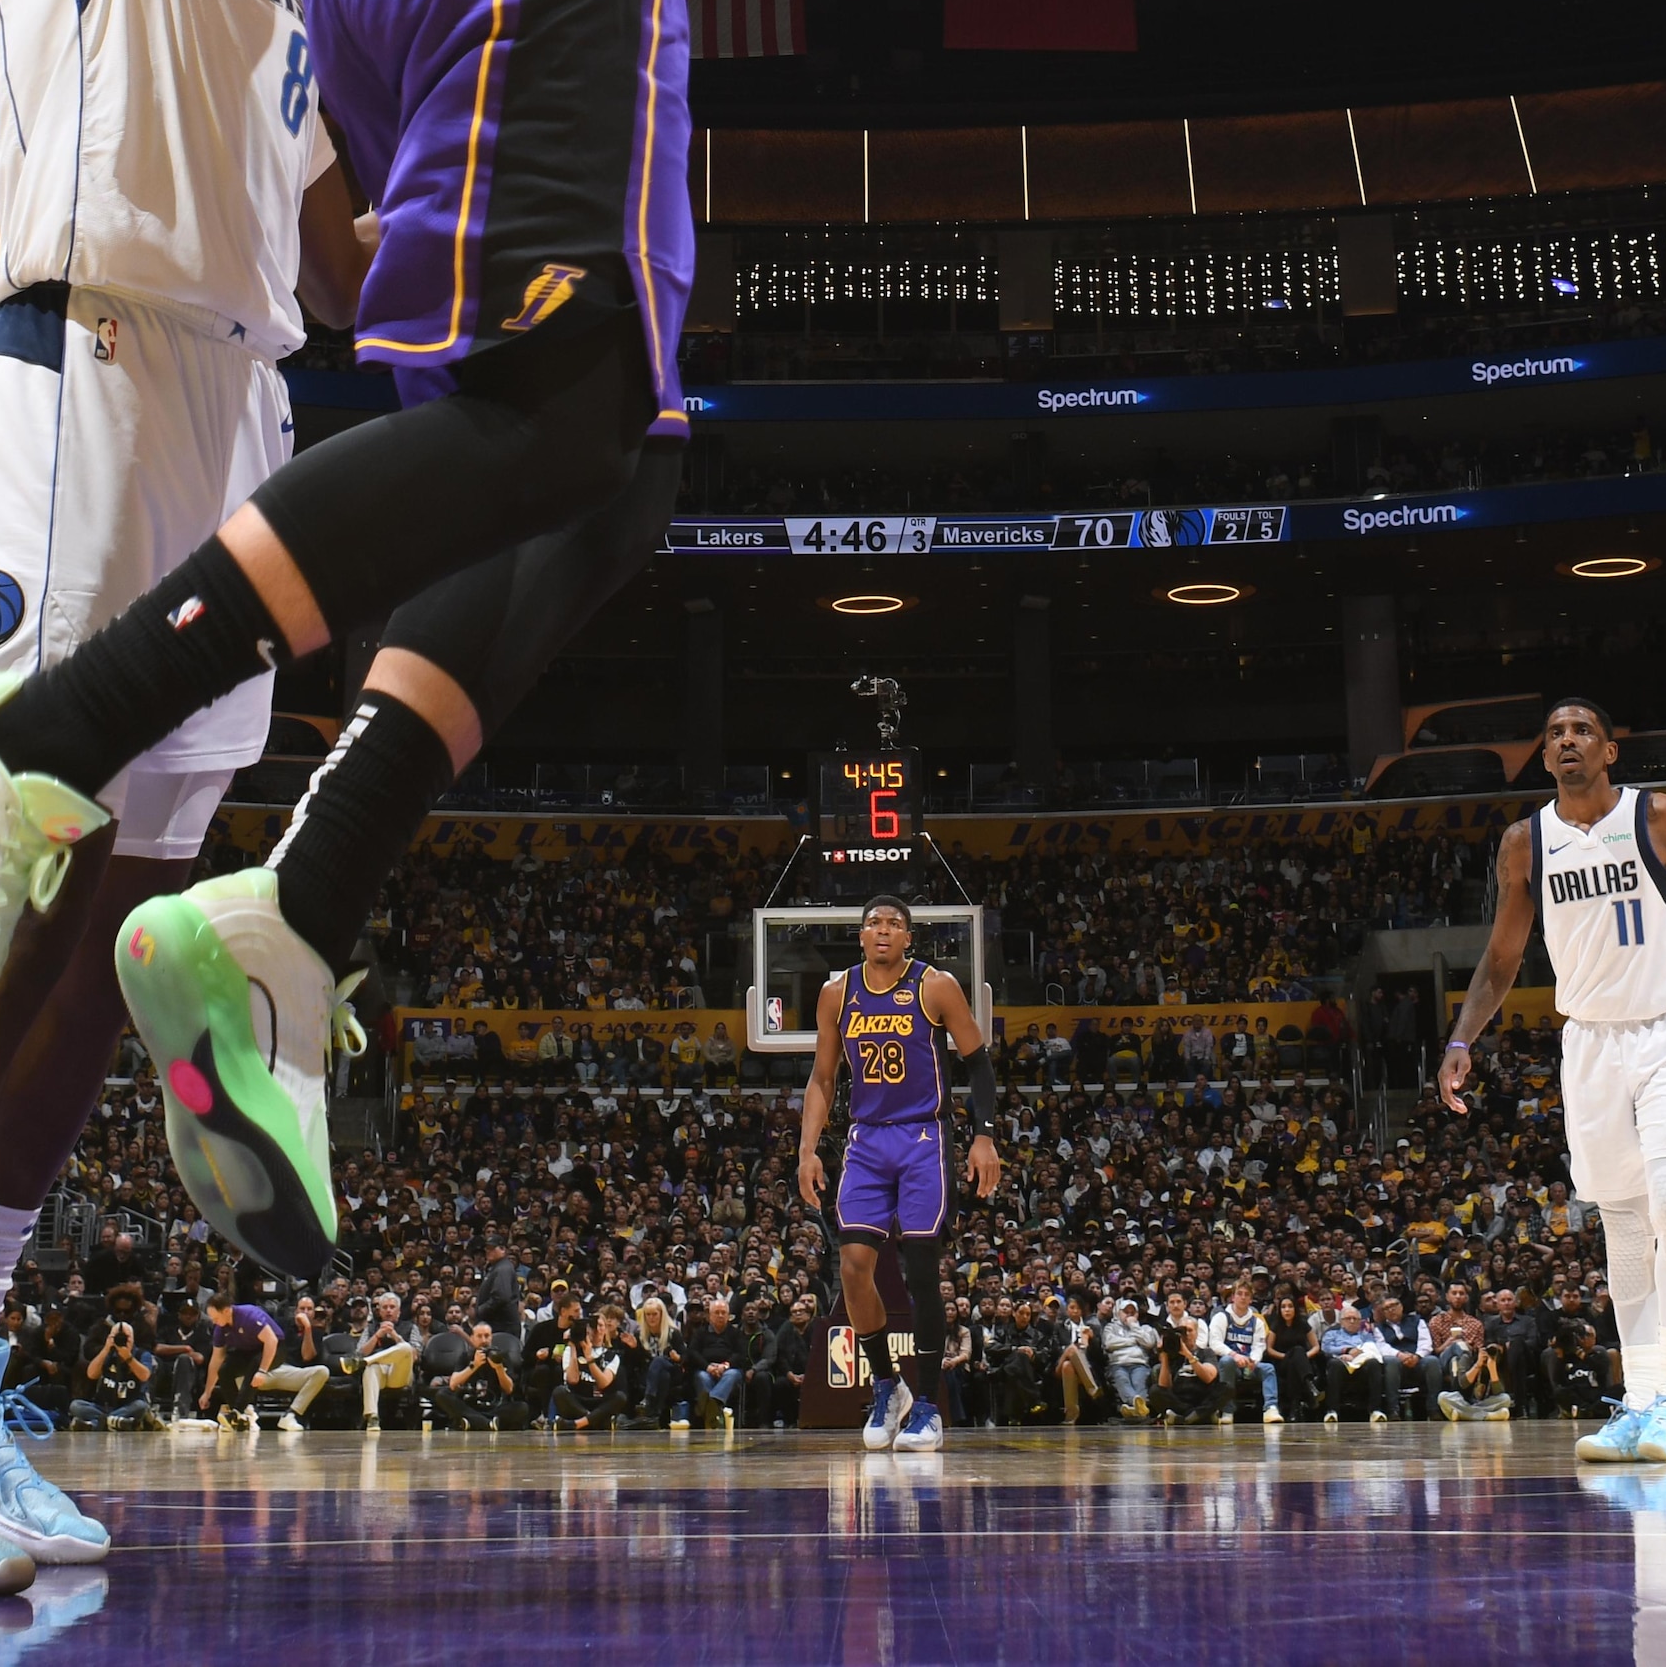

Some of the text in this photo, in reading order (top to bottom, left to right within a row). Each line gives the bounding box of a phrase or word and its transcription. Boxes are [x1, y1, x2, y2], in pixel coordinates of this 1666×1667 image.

[281, 29, 314, 139] 8
[1471, 357, 1575, 385] Spectrum
[1036, 389, 1138, 412] Spectrum
[910, 518, 927, 527] QTR
[1217, 511, 1247, 522] FOULS
[1256, 510, 1275, 520] TOL
[1342, 503, 1457, 534] Spectrum
[696, 527, 764, 546] Lakers
[803, 521, 888, 553] 4:46
[912, 530, 926, 552] 3
[942, 525, 1045, 544] Mavericks
[1074, 519, 1115, 547] 70
[1224, 523, 1238, 541] 2
[1259, 522, 1273, 540] 5
[844, 762, 903, 788] 4:45
[870, 790, 899, 839] 6
[1010, 816, 1116, 848] LOS
[1130, 808, 1389, 844] ANGELES
[517, 816, 741, 851] LAKERS
[1602, 832, 1633, 844] chime
[846, 848, 912, 863] TISSOT
[1548, 860, 1639, 904] DALLAS
[1612, 899, 1645, 947] 11
[846, 1010, 914, 1038] LAKERS
[858, 1040, 906, 1084] 28
